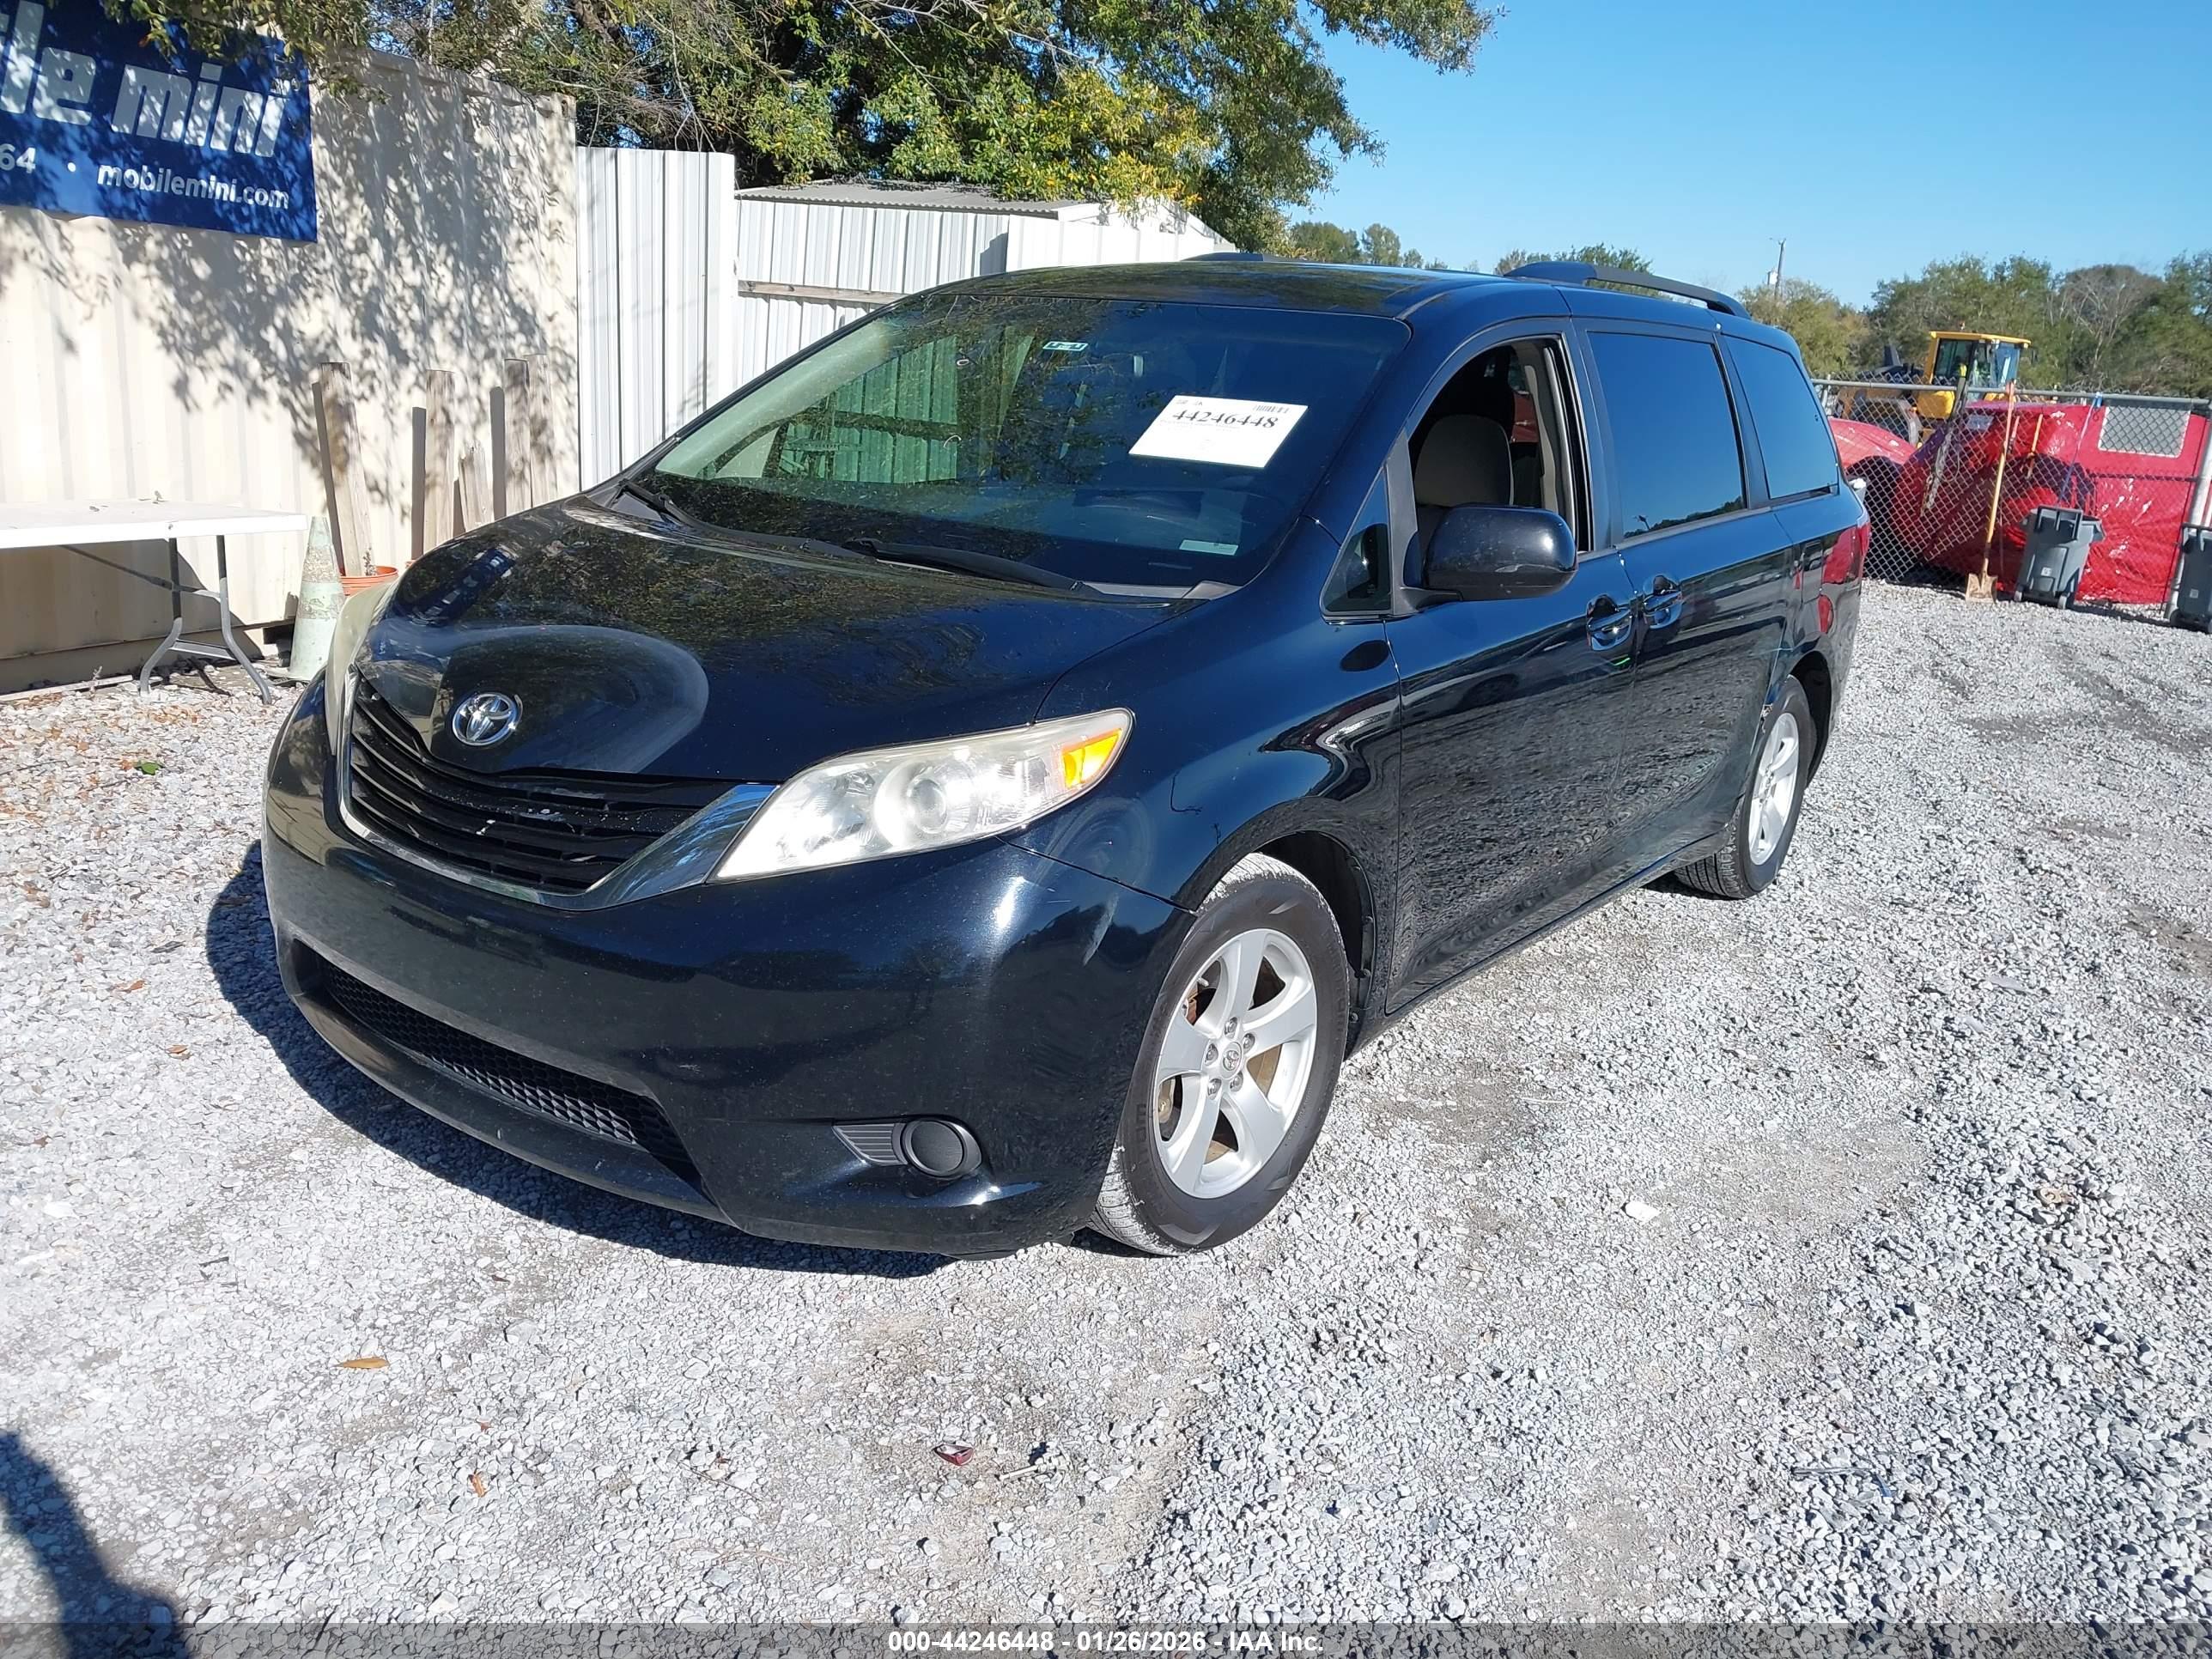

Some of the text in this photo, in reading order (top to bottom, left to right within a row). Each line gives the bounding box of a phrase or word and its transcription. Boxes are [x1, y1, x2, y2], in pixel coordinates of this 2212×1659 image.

[0, 0, 286, 158] le mini
[97, 164, 289, 210] mobilemini.com
[1172, 410, 1279, 428] 44246448
